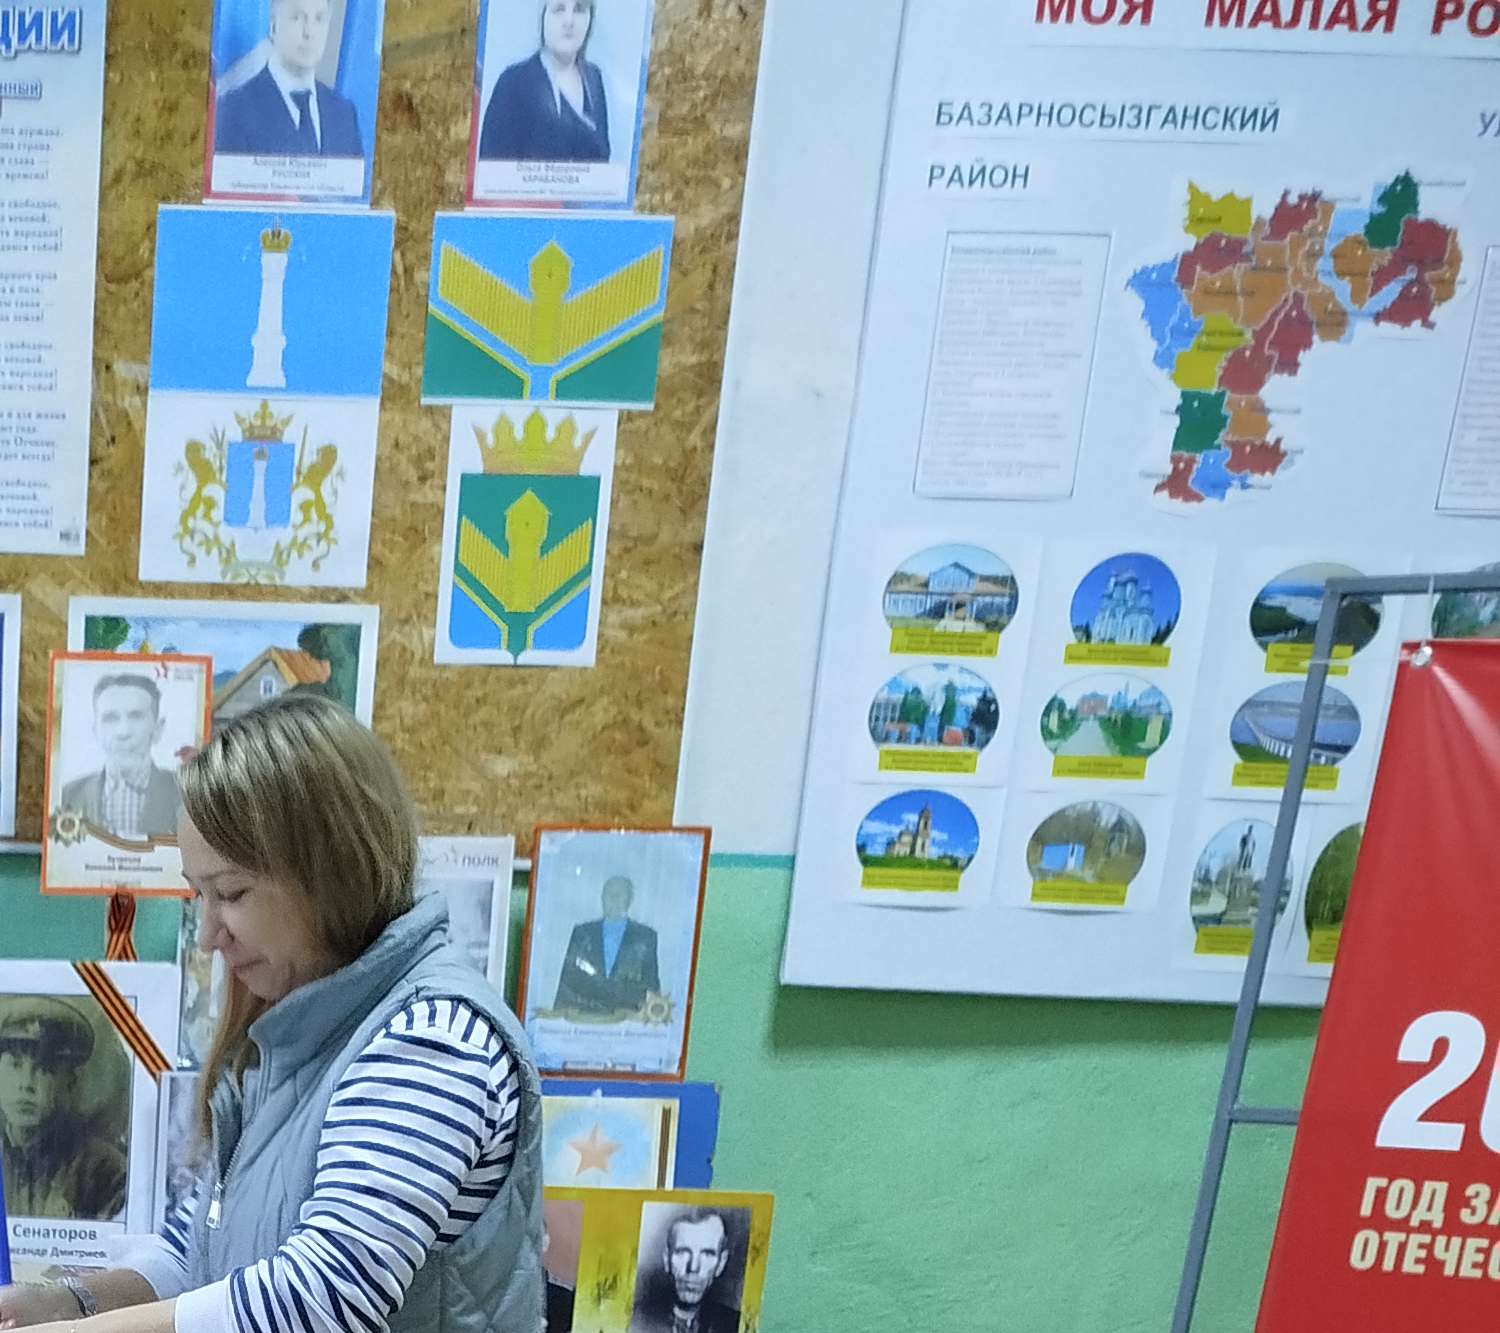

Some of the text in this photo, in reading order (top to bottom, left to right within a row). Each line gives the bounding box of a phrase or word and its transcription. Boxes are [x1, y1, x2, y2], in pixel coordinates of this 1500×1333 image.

[1035, 0, 1154, 26] МОЯ
[1204, 0, 1399, 34] МАЛАЯ
[935, 100, 1281, 133] БАЗАРНОСЫЗГАНСКИЙ
[1477, 111, 1500, 138] У
[928, 158, 1030, 189] РАЙОН
[1375, 1010, 1500, 1155] 2
[1360, 1177, 1449, 1228] ГОД
[12, 1223, 98, 1242] Сенаторов
